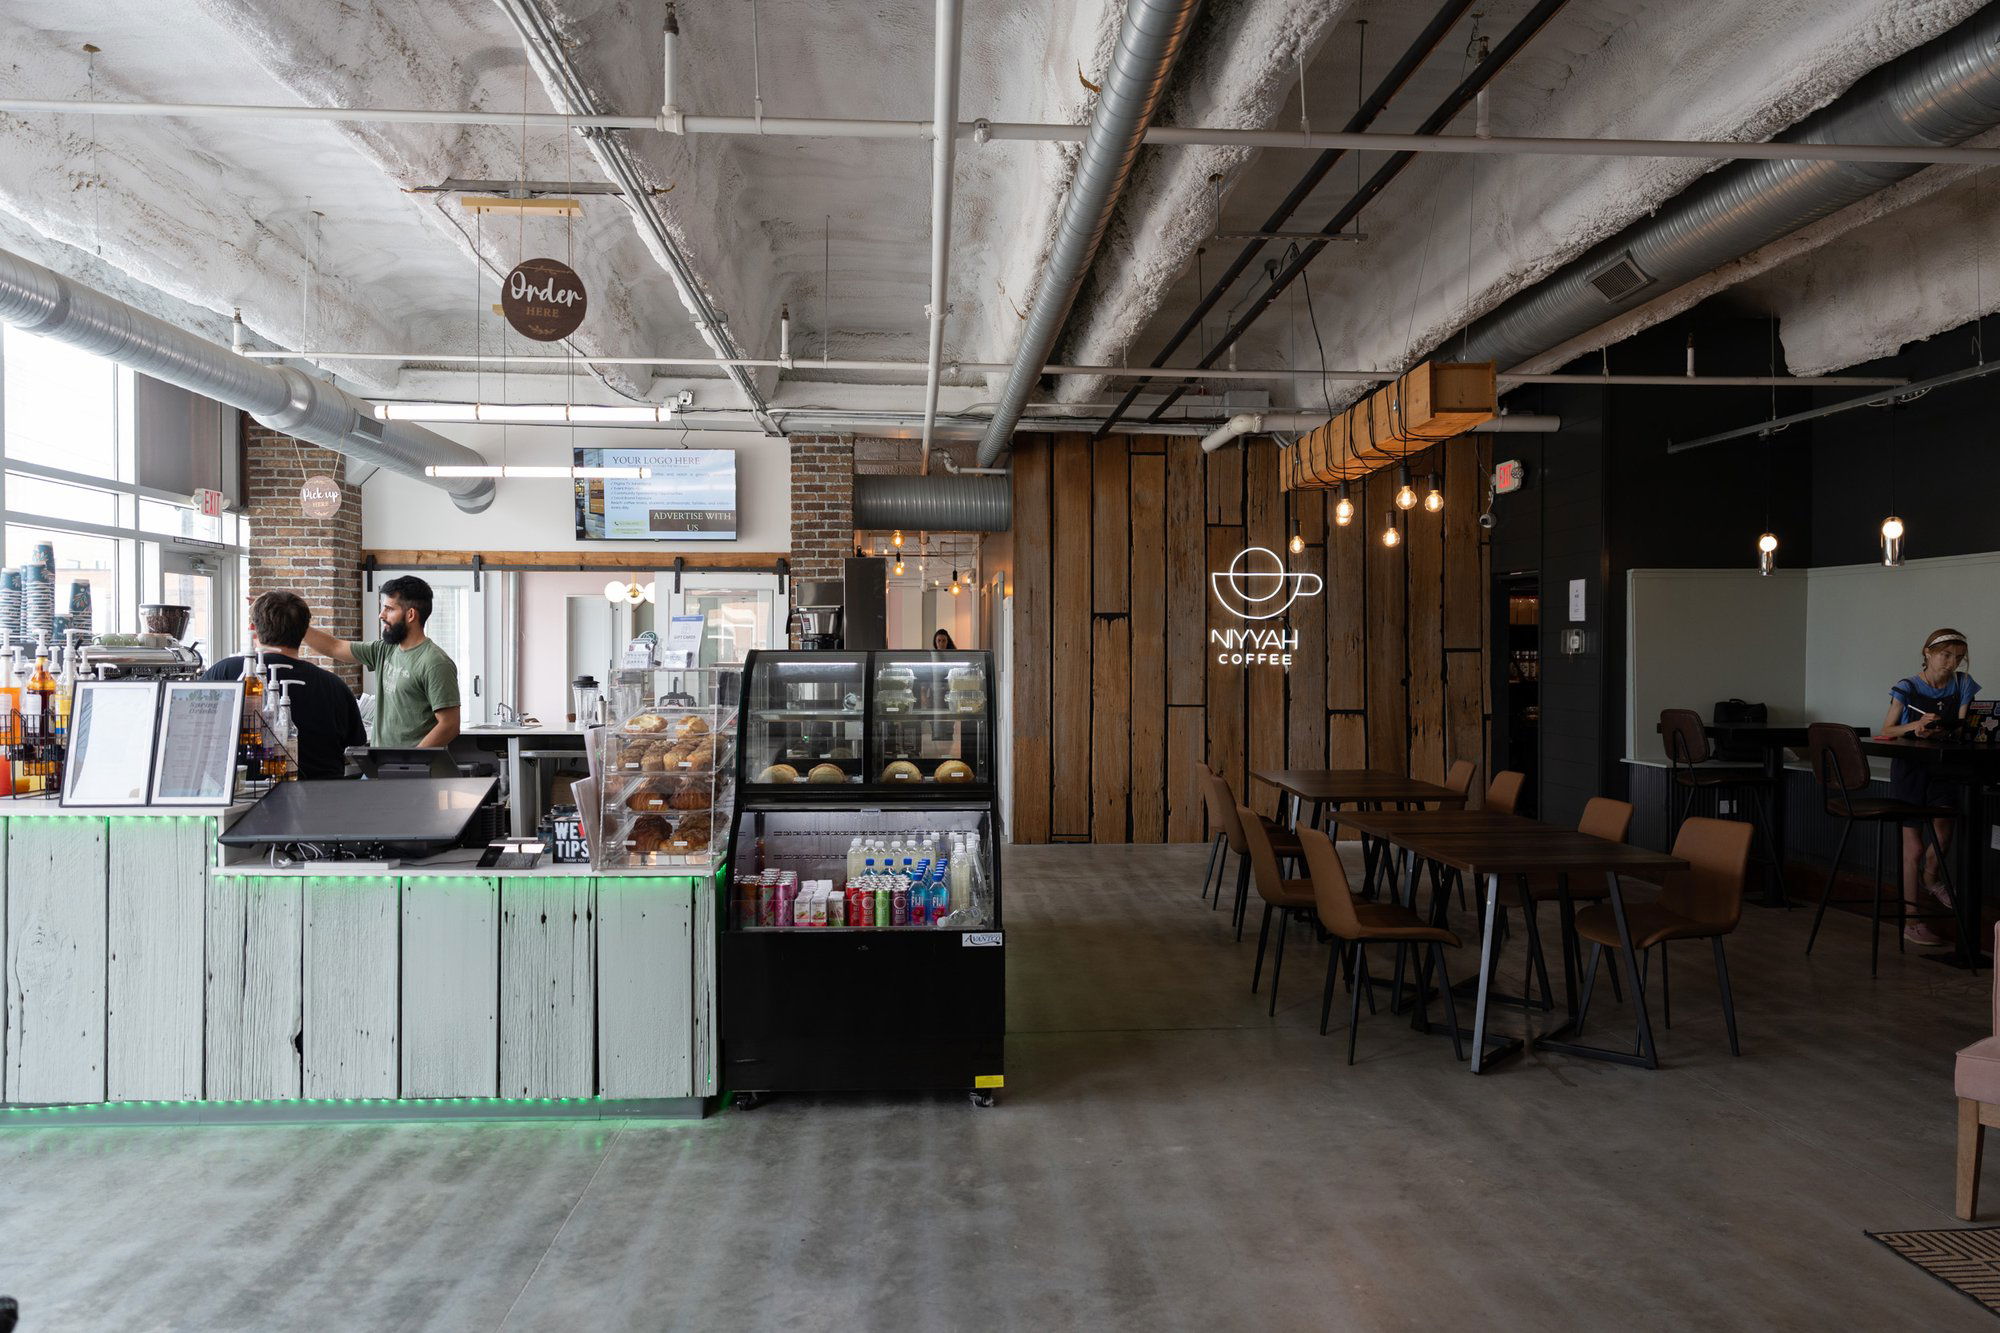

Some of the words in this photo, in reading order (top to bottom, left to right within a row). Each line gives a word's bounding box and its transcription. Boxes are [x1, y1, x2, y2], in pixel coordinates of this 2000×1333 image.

[511, 271, 583, 308] Order
[526, 306, 560, 318] HERE
[612, 456, 641, 465] YOUR
[644, 456, 673, 465] LOGO
[675, 456, 701, 465] HERE
[302, 487, 324, 502] Pick
[324, 490, 341, 504] up
[204, 490, 221, 515] EXIT
[653, 512, 703, 520] ADVERTISE
[705, 512, 732, 520] WITH
[686, 524, 700, 532] US
[1211, 629, 1298, 650] NIYYAH
[1218, 653, 1292, 665] COFFEE
[554, 822, 579, 840] WE
[555, 840, 590, 858] TIPS
[911, 895, 925, 907] FIJI
[932, 896, 945, 908] FIJI
